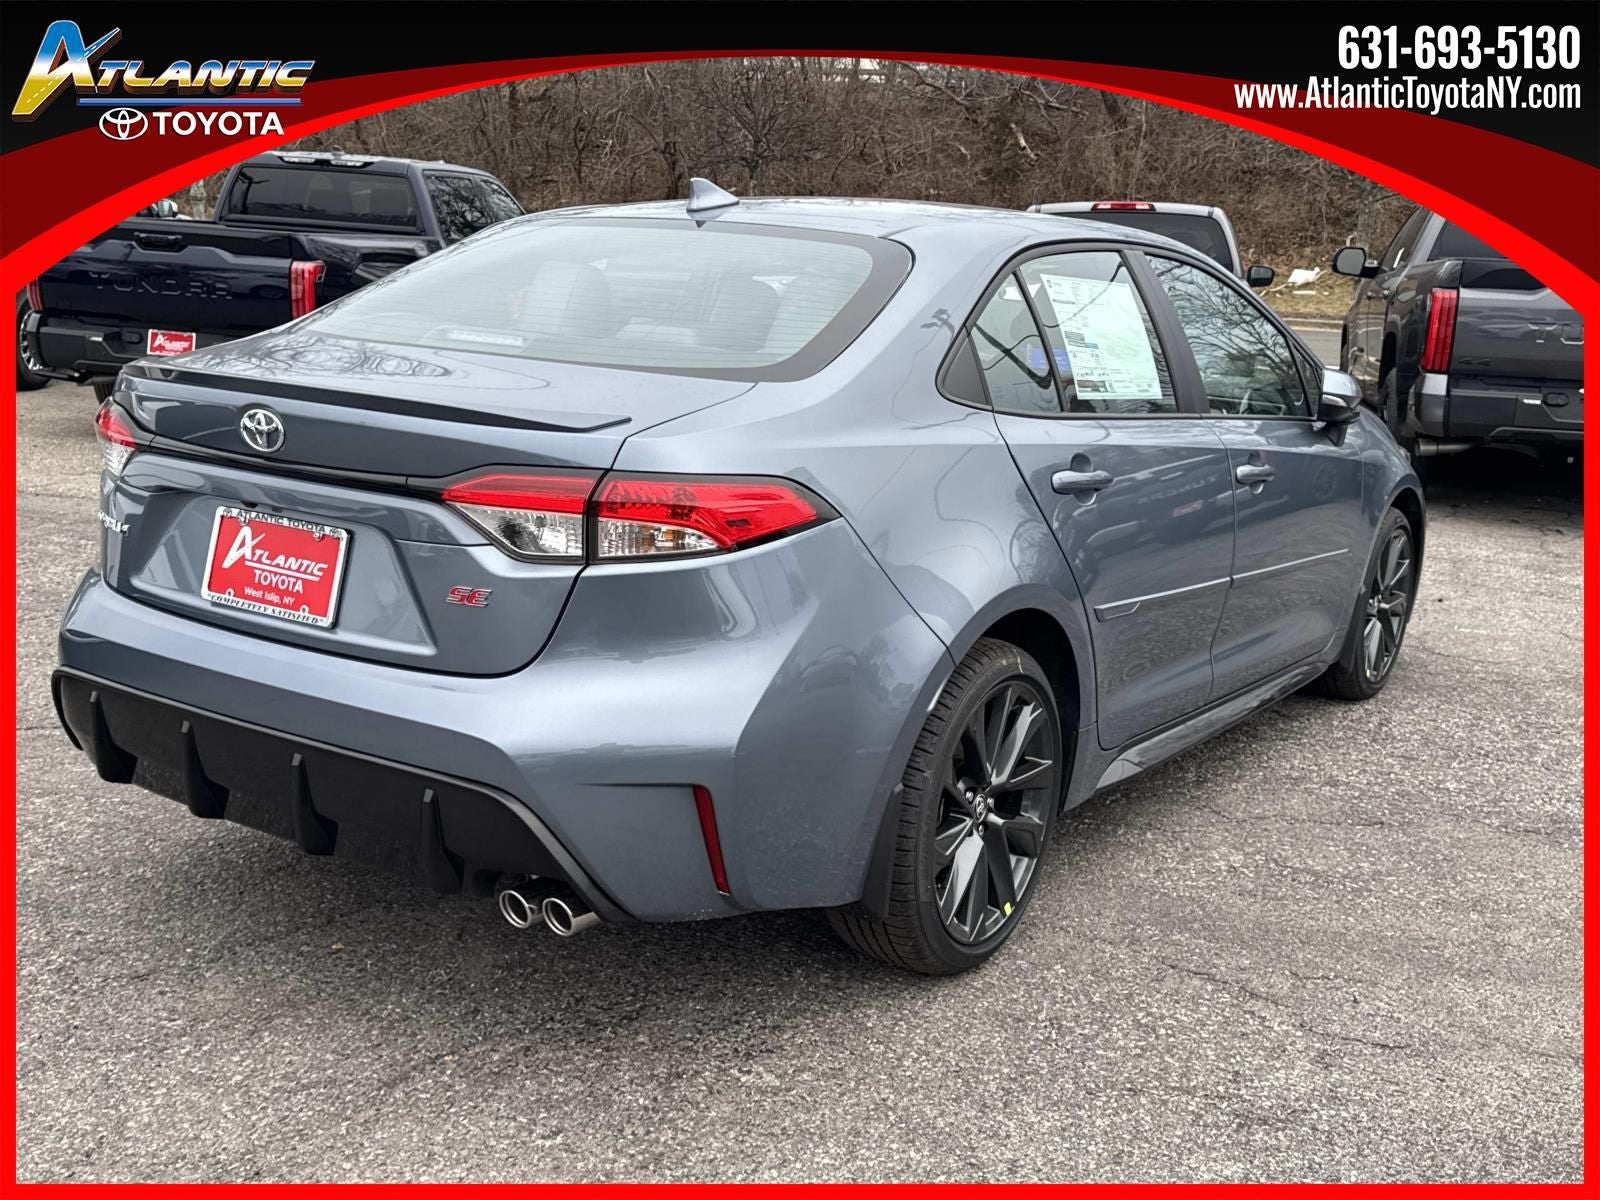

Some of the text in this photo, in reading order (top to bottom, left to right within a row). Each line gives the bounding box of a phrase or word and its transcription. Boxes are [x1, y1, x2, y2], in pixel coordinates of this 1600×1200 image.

[88, 271, 233, 300] TUNDRA
[236, 510, 326, 533] ATLANTIC TOYOTA
[222, 525, 328, 577] ATLANTIC
[254, 570, 304, 594] TOYOTA
[244, 586, 264, 599] West
[283, 596, 296, 607] NY
[447, 586, 492, 608] SE
